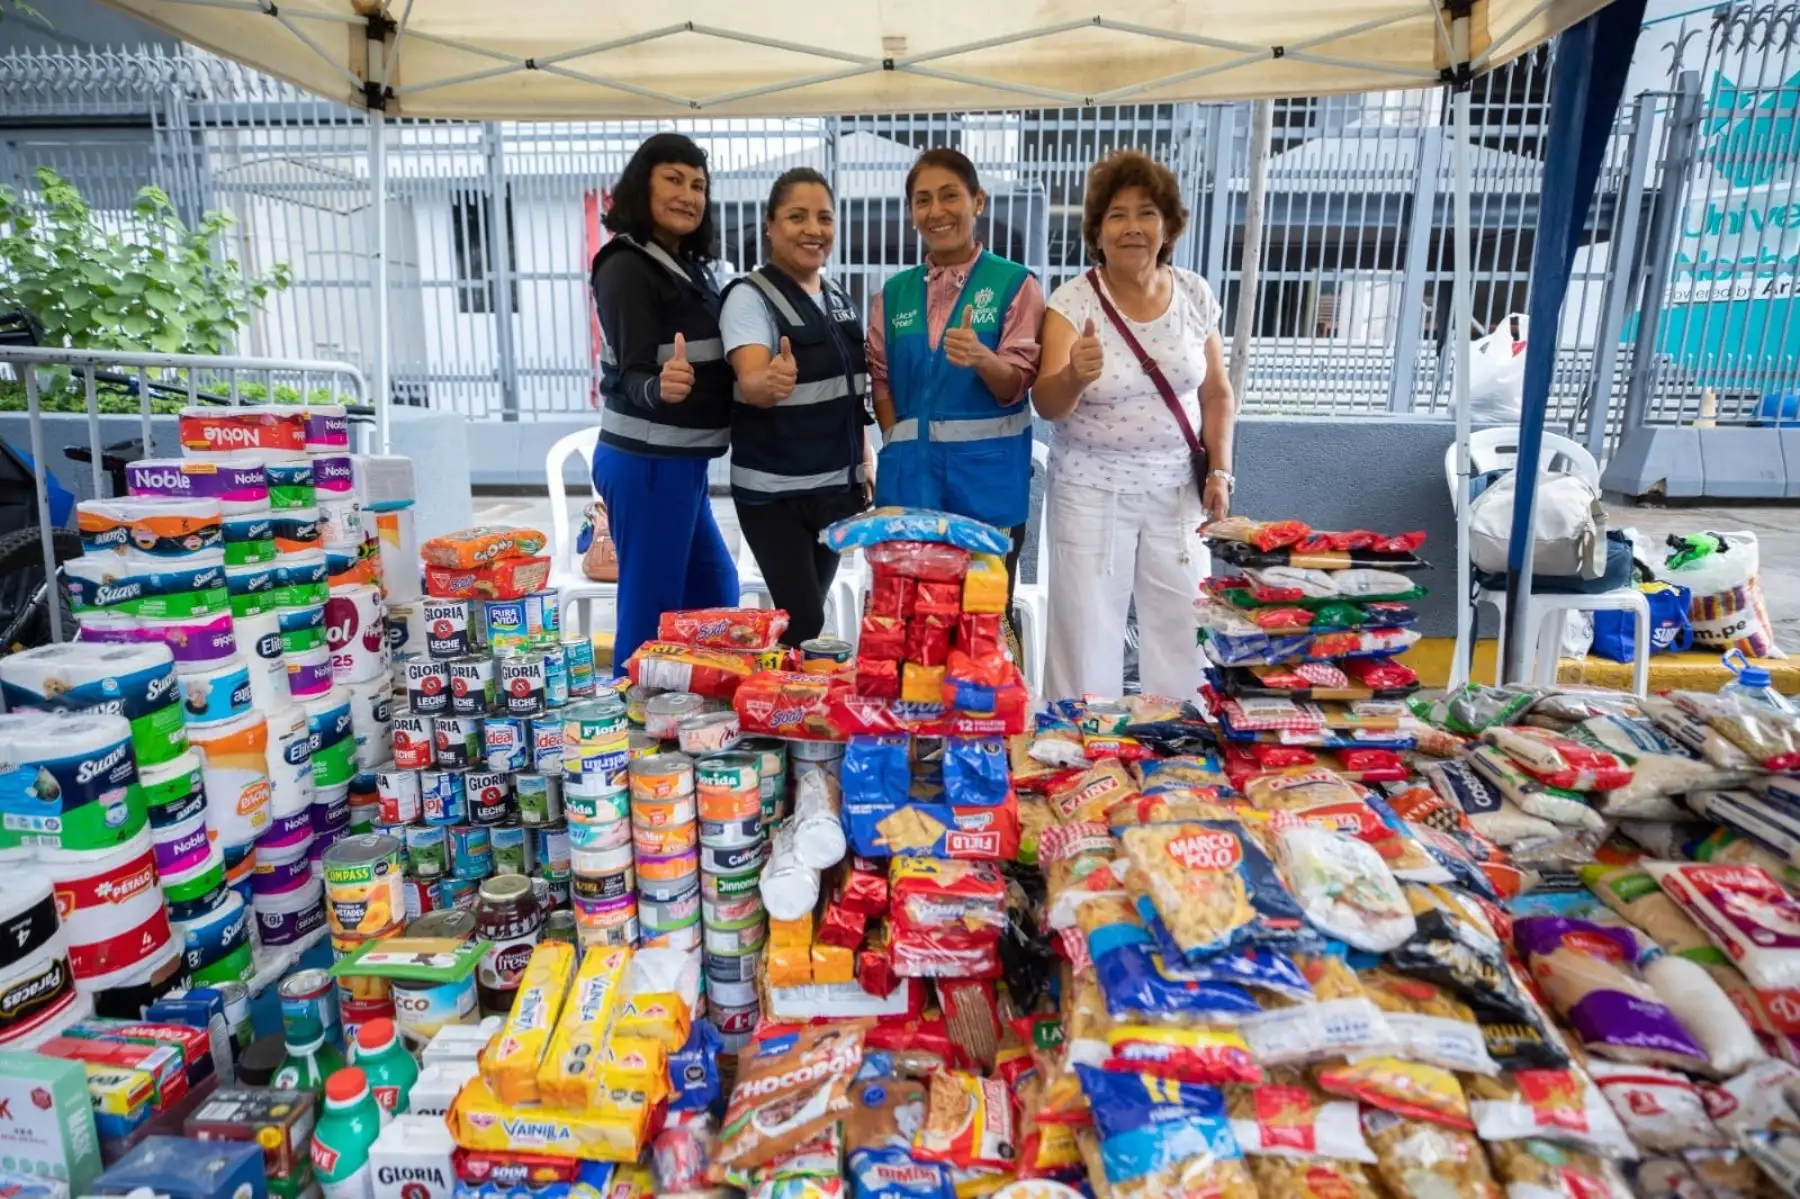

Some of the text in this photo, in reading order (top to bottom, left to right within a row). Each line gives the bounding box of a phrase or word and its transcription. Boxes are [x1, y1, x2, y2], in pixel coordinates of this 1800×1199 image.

[970, 311, 996, 324] IMA
[134, 469, 191, 489] Noble
[94, 582, 142, 606] Suave
[424, 606, 464, 621] GLORIA
[1694, 619, 1747, 641] m.pe
[212, 633, 236, 648] oble
[431, 639, 460, 649] LECHE
[332, 655, 353, 668] 25
[452, 666, 480, 680] ORIA
[503, 665, 541, 680] GLORIA
[394, 718, 423, 733] ORIA
[957, 720, 973, 731] 12
[952, 835, 993, 849] FIELD
[1168, 833, 1235, 858] MARCO
[1184, 849, 1234, 869] POLO
[326, 867, 370, 882] COMPASS
[112, 871, 151, 897] PÉTALO
[17, 929, 31, 948] 4
[2, 967, 61, 1010] Paracas
[502, 1119, 571, 1141] VAINILLA
[378, 1166, 446, 1189] GLORIA
